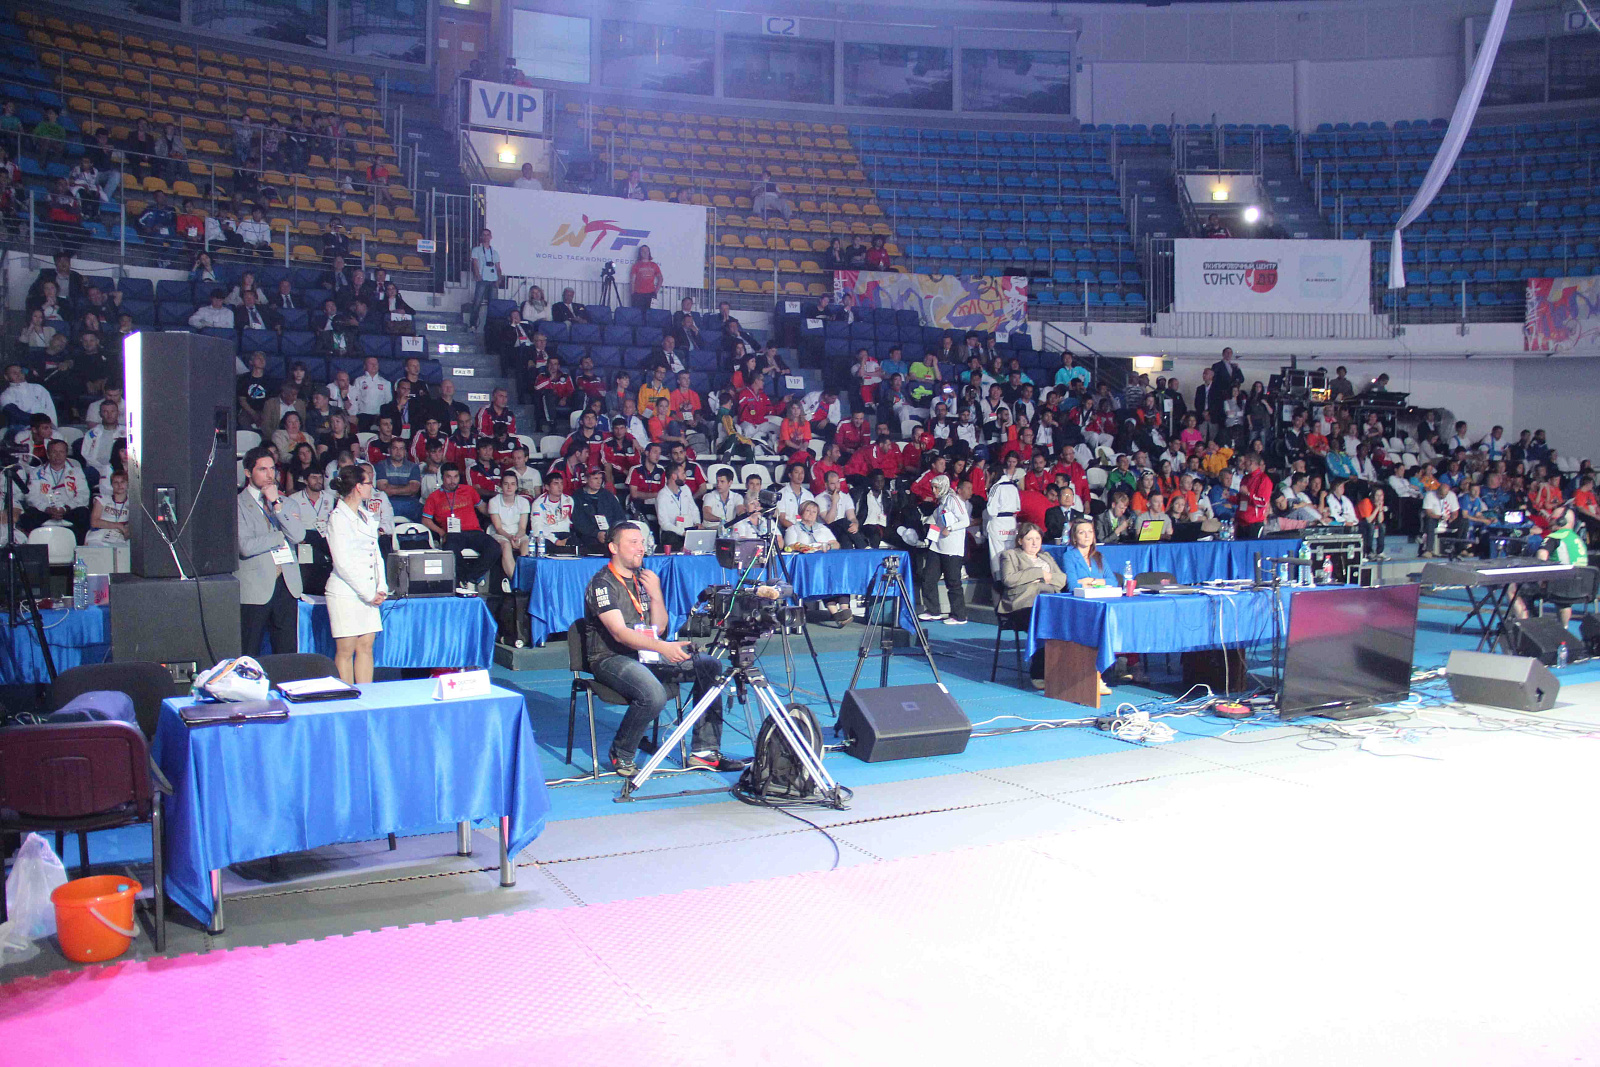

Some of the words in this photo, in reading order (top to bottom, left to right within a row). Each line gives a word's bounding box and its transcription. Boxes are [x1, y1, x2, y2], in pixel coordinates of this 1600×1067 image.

[766, 17, 795, 35] C2
[479, 87, 537, 123] VIP
[550, 213, 651, 253] WTF
[535, 253, 563, 261] WORLD
[566, 255, 613, 264] TAEKWONDO
[1203, 273, 1244, 285] СОНСУ
